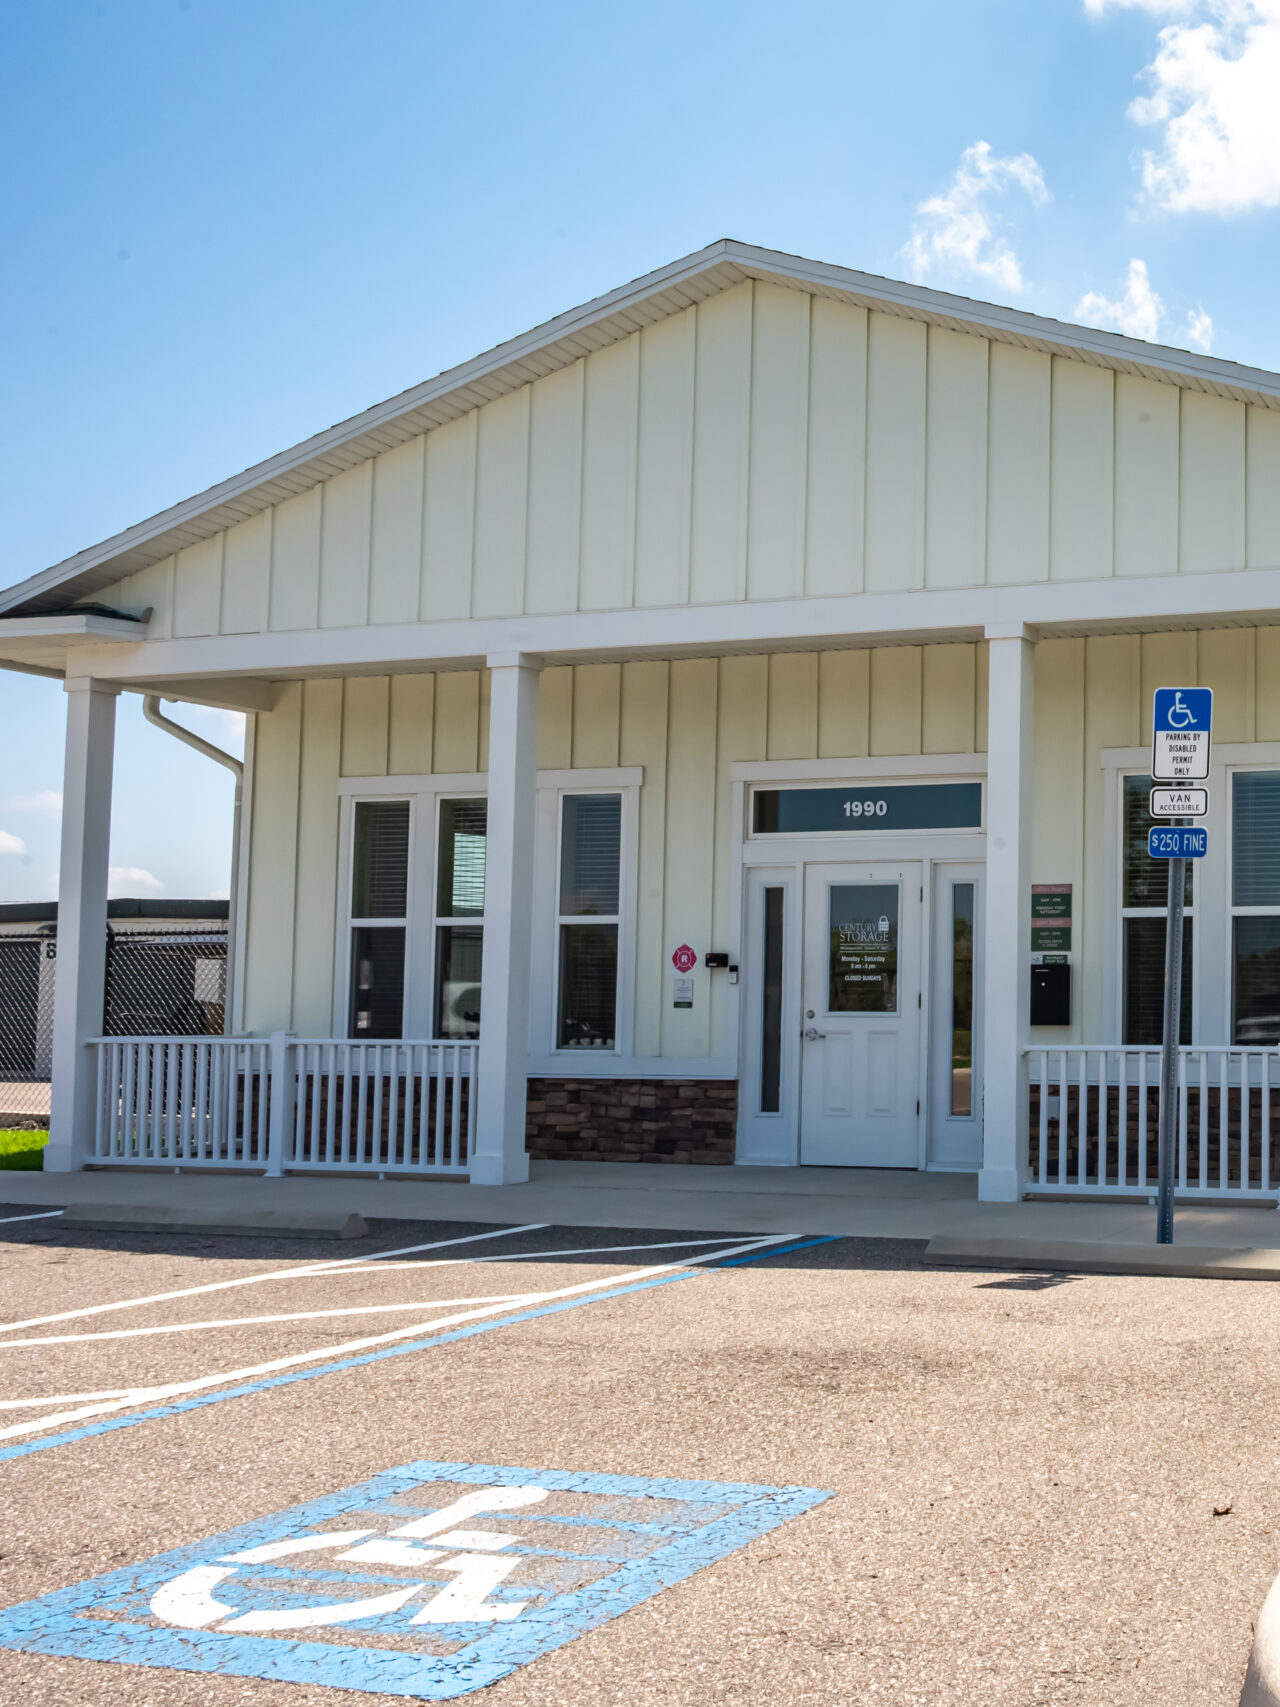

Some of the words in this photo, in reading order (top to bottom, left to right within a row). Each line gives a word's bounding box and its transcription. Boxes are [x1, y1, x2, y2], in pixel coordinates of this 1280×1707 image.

[1166, 733, 1191, 741] PARKING
[1169, 745, 1197, 753] DISABLED
[1172, 756, 1193, 764] PERMIT
[1174, 767, 1190, 776] ONLY
[1169, 794, 1191, 803] VAN
[843, 800, 888, 817] 1990
[1151, 834, 1180, 852] $250
[1183, 834, 1205, 852] FINE
[839, 922, 877, 931] CENTURY
[840, 931, 889, 942] STORAGE
[681, 954, 688, 963] R
[841, 955, 860, 963] Monday
[864, 955, 886, 963] Saturday
